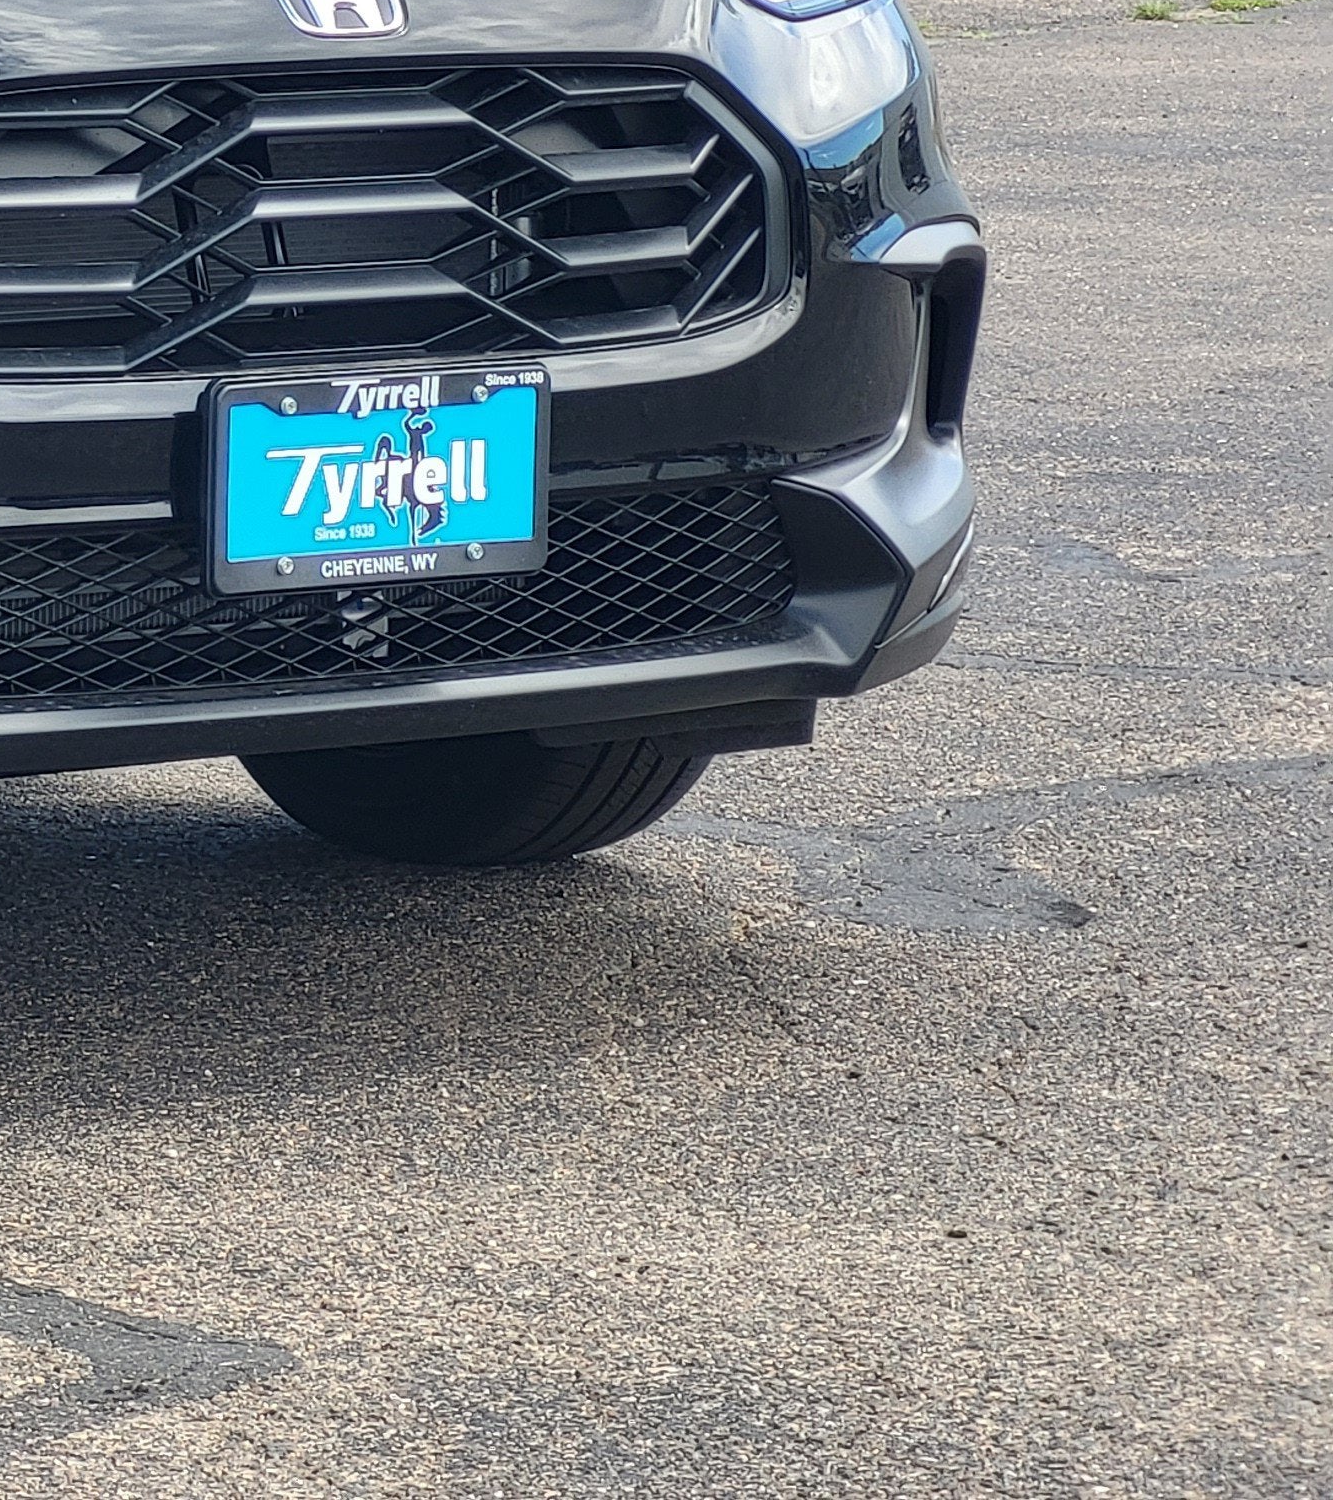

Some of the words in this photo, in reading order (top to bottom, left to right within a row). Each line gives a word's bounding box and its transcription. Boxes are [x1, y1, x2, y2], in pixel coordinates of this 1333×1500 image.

[485, 373, 516, 386] Since
[517, 371, 544, 385] 1938
[331, 375, 440, 418] Tyrrell
[265, 439, 487, 526] Tyrrell
[314, 526, 346, 542] Since
[348, 523, 376, 539] 1938
[321, 556, 409, 579] CHEYENNE,
[411, 553, 438, 571] WY
